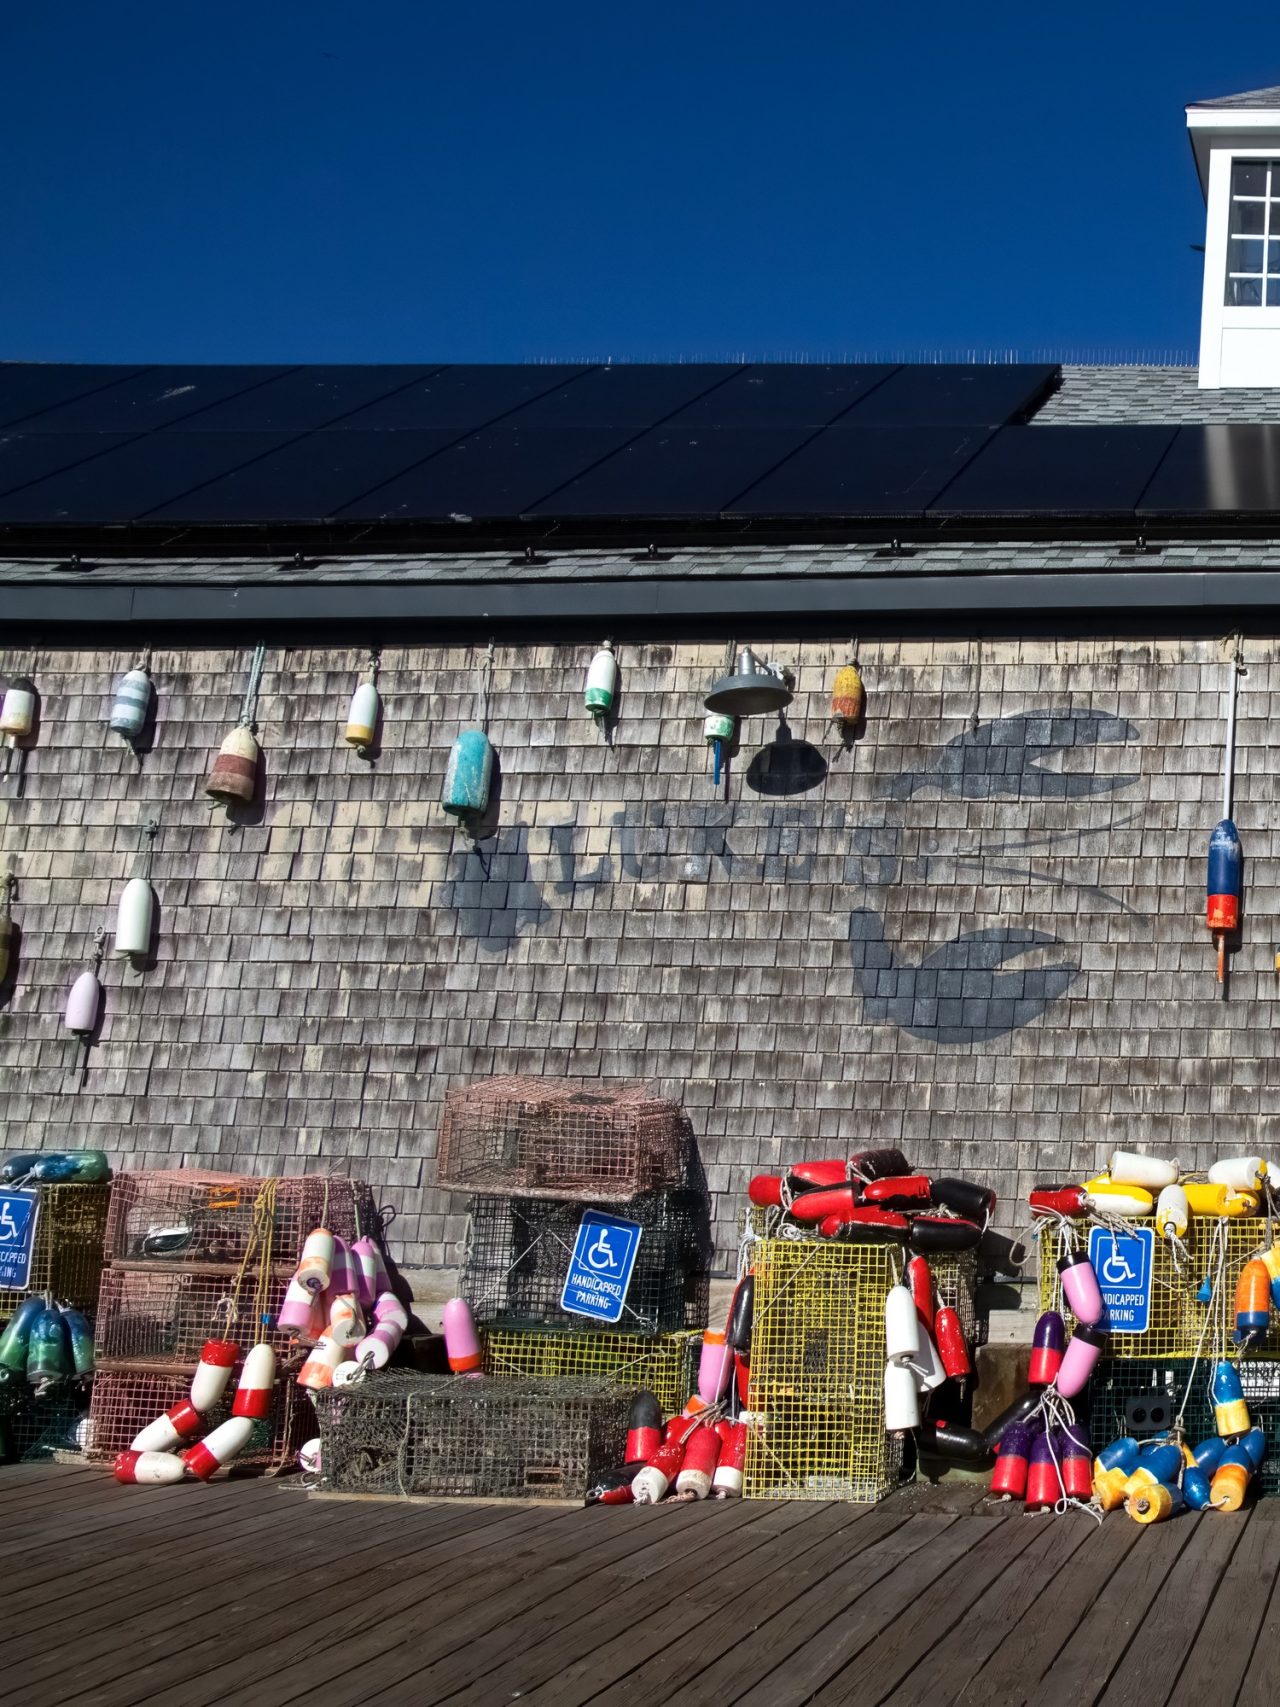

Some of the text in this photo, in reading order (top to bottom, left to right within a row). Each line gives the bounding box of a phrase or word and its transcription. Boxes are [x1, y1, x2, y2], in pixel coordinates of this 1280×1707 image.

[0, 1251, 26, 1264] CAPPED
[571, 1274, 621, 1296] HANDICAPPED
[576, 1291, 609, 1309] PARKING
